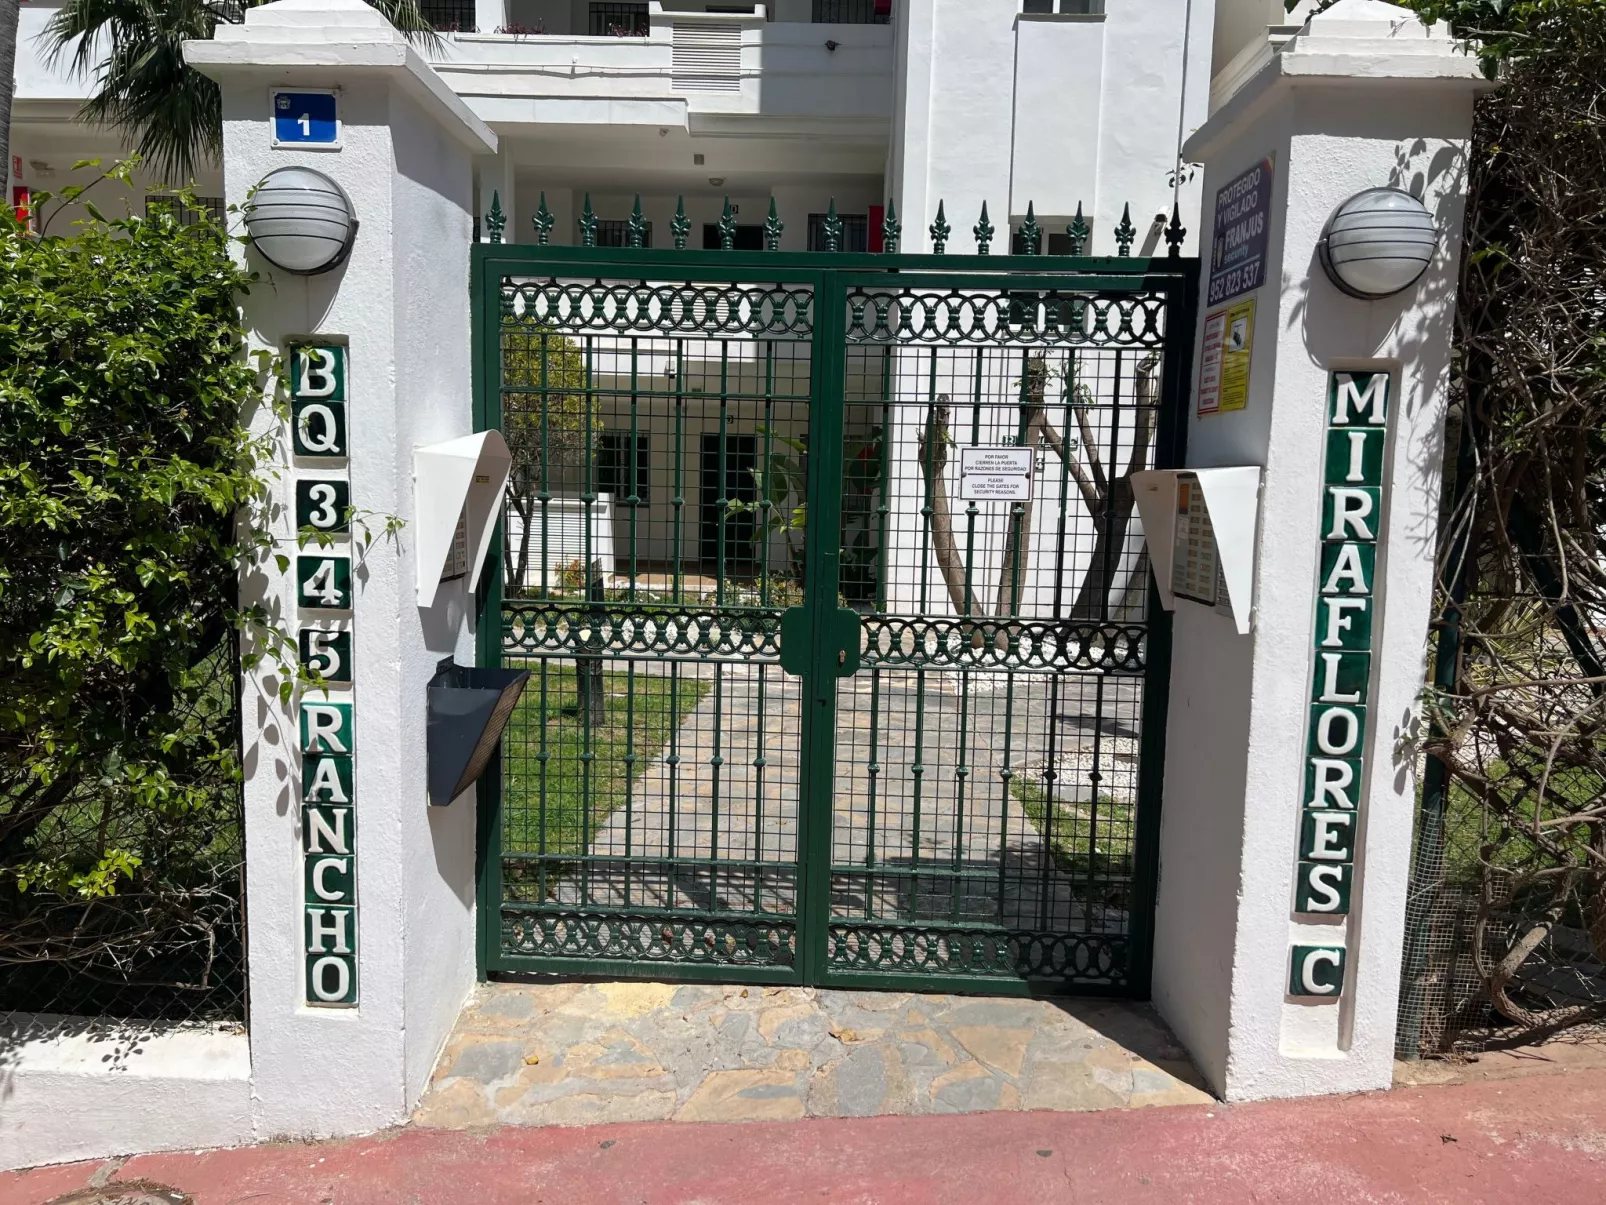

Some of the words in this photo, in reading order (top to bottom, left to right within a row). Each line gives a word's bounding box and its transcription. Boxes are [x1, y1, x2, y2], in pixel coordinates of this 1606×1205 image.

[298, 113, 310, 136] 1
[1218, 168, 1261, 208] PROTEGIDO
[1218, 211, 1223, 228] Y
[1223, 190, 1258, 225] VIGILADO
[1225, 212, 1264, 250] FRANJUS
[1209, 279, 1224, 302] 952
[1225, 270, 1241, 296] 823
[1242, 261, 1260, 289] 537
[309, 484, 337, 528] 3
[303, 560, 343, 605] 4
[309, 632, 340, 678] 5
[1307, 373, 1389, 913] MIRAFLORES
[302, 705, 350, 1000] RANCHO
[1302, 949, 1340, 993] C
